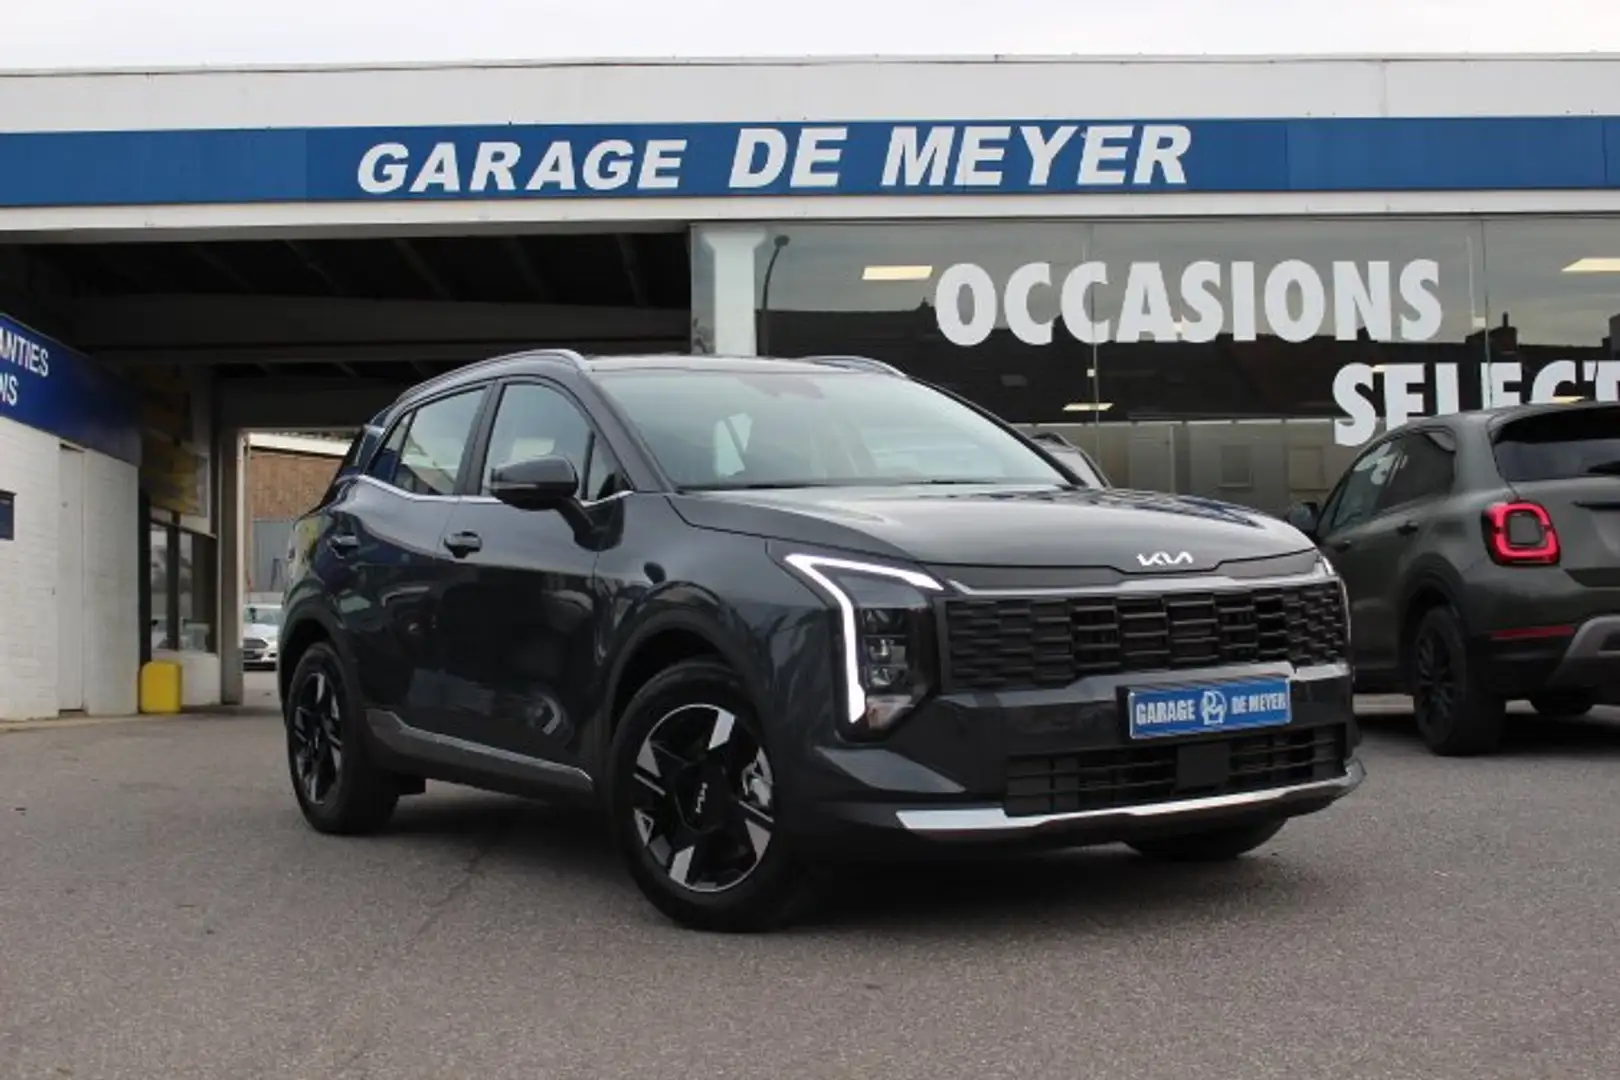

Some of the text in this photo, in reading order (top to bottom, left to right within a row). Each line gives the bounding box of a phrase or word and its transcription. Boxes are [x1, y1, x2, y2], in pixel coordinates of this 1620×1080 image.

[357, 125, 1192, 194] GARAGE DE MEYER
[935, 259, 1443, 346] OCCASIONS
[1136, 551, 1194, 567] KIA
[1136, 699, 1196, 726] GARAGE
[1231, 696, 1247, 715] DE
[1248, 692, 1286, 713] MEYER
